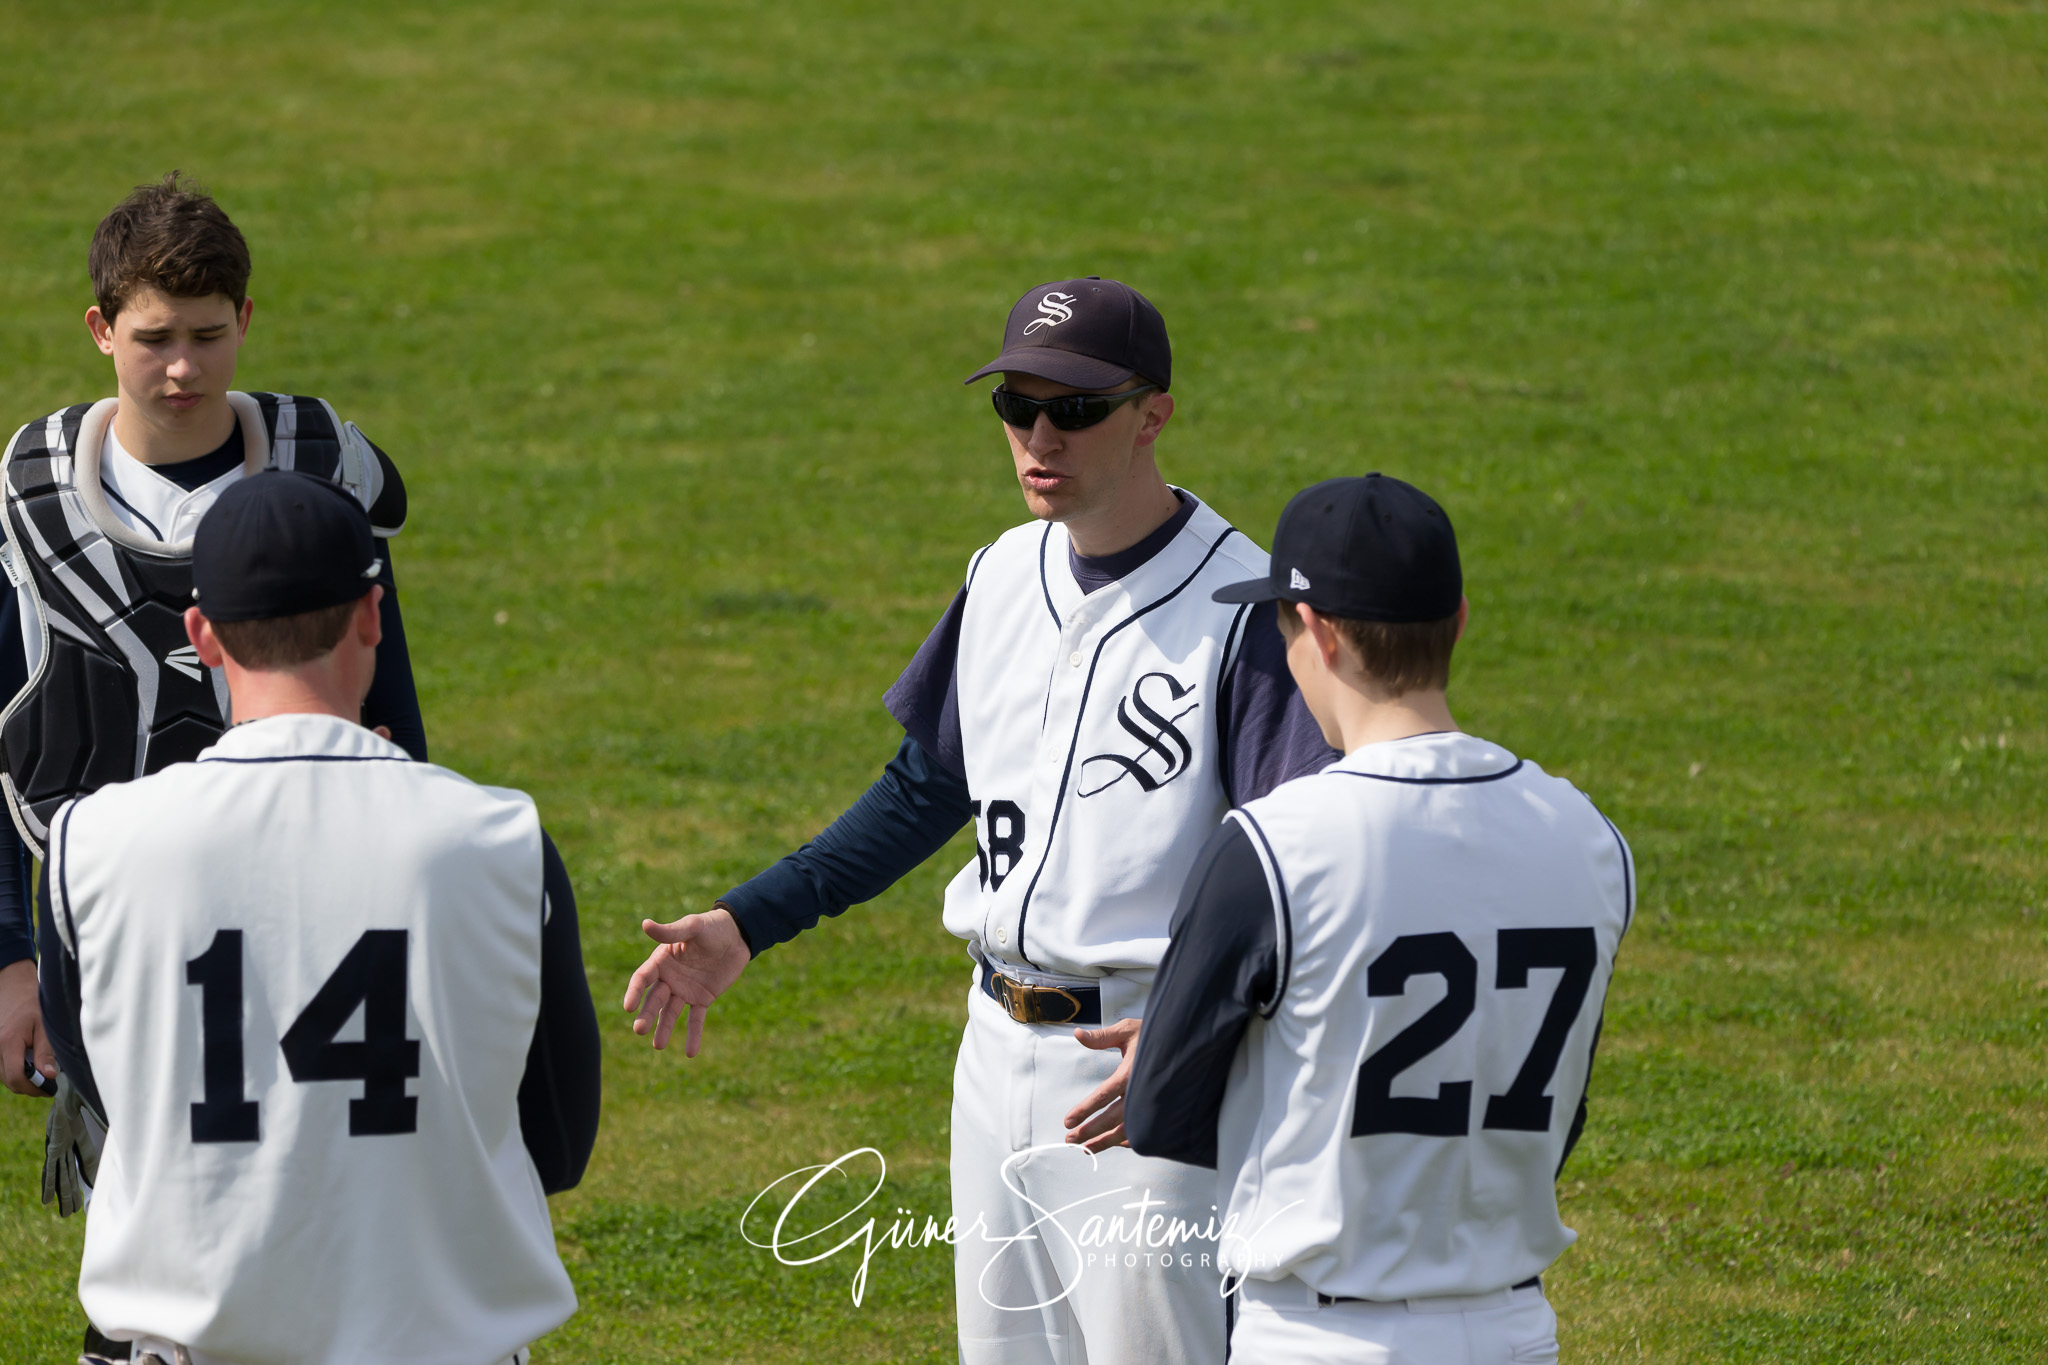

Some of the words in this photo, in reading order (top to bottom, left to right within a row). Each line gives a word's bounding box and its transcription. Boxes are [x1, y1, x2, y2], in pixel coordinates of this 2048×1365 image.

[1023, 291, 1077, 336] S
[1077, 671, 1200, 799] S
[186, 929, 421, 1143] 14
[1350, 926, 1597, 1138] 27
